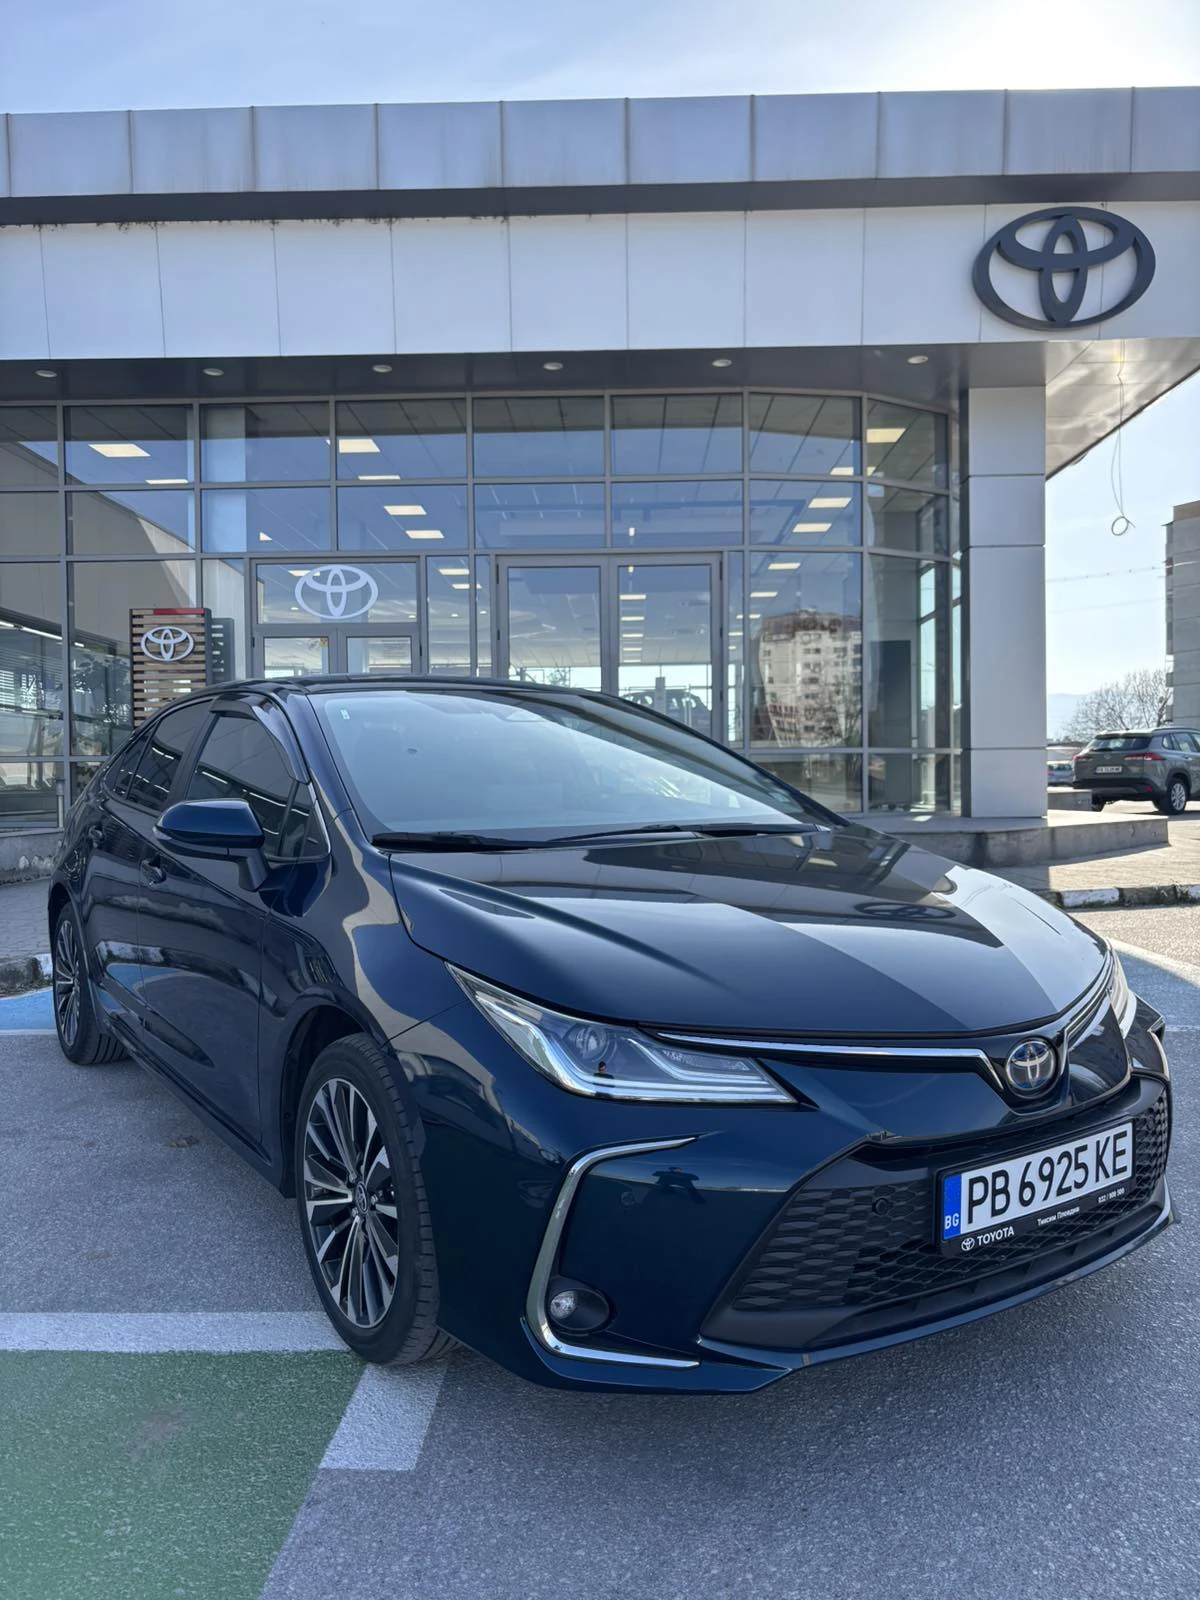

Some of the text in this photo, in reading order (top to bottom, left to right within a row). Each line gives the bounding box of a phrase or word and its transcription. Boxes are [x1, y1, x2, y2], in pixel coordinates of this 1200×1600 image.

[968, 1130, 1127, 1224] PB 6925 KE
[945, 1213, 959, 1230] BG
[977, 1226, 1015, 1246] TOYOTA
